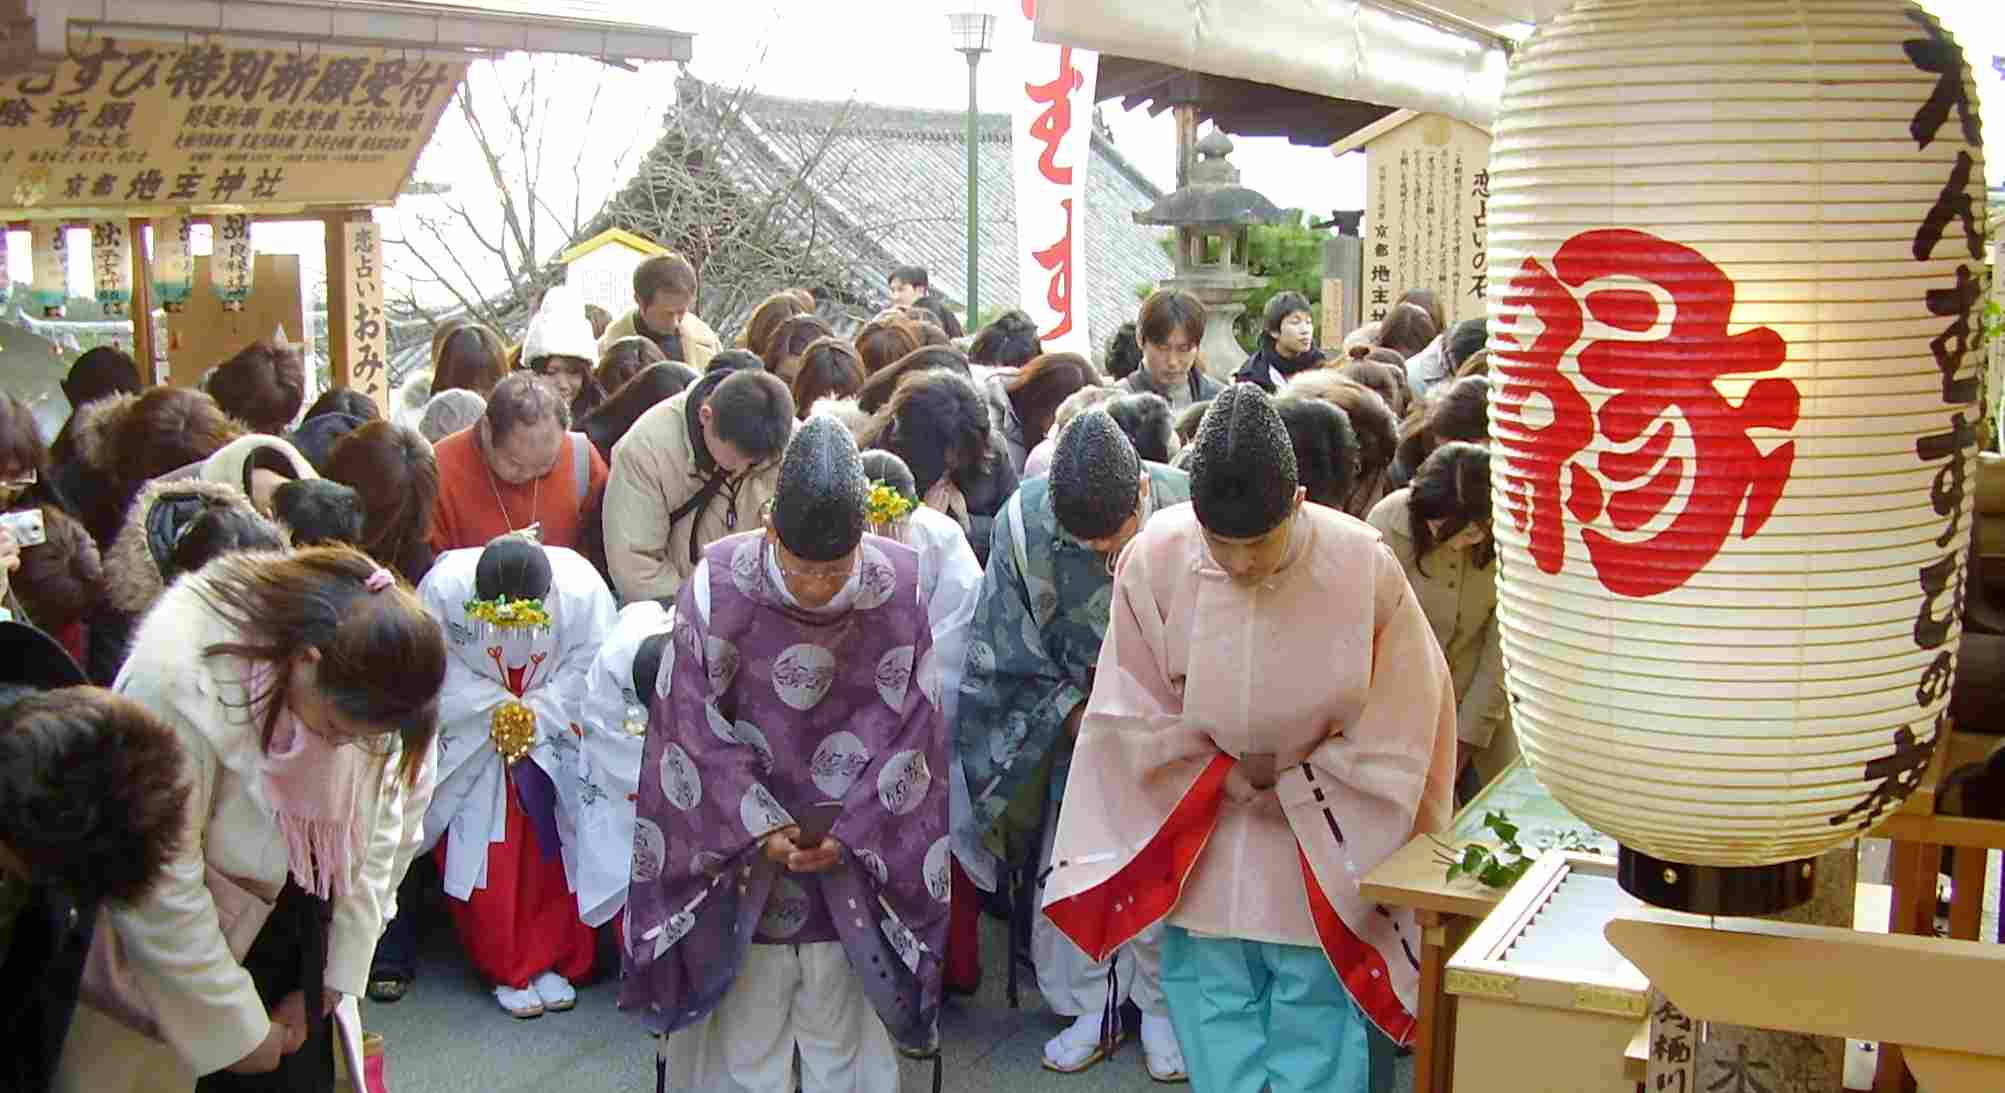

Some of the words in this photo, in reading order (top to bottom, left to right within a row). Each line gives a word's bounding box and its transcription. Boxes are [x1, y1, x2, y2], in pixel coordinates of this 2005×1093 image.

[1022, 0, 1084, 341] むす
[1467, 168, 1490, 300] 恋占いの石
